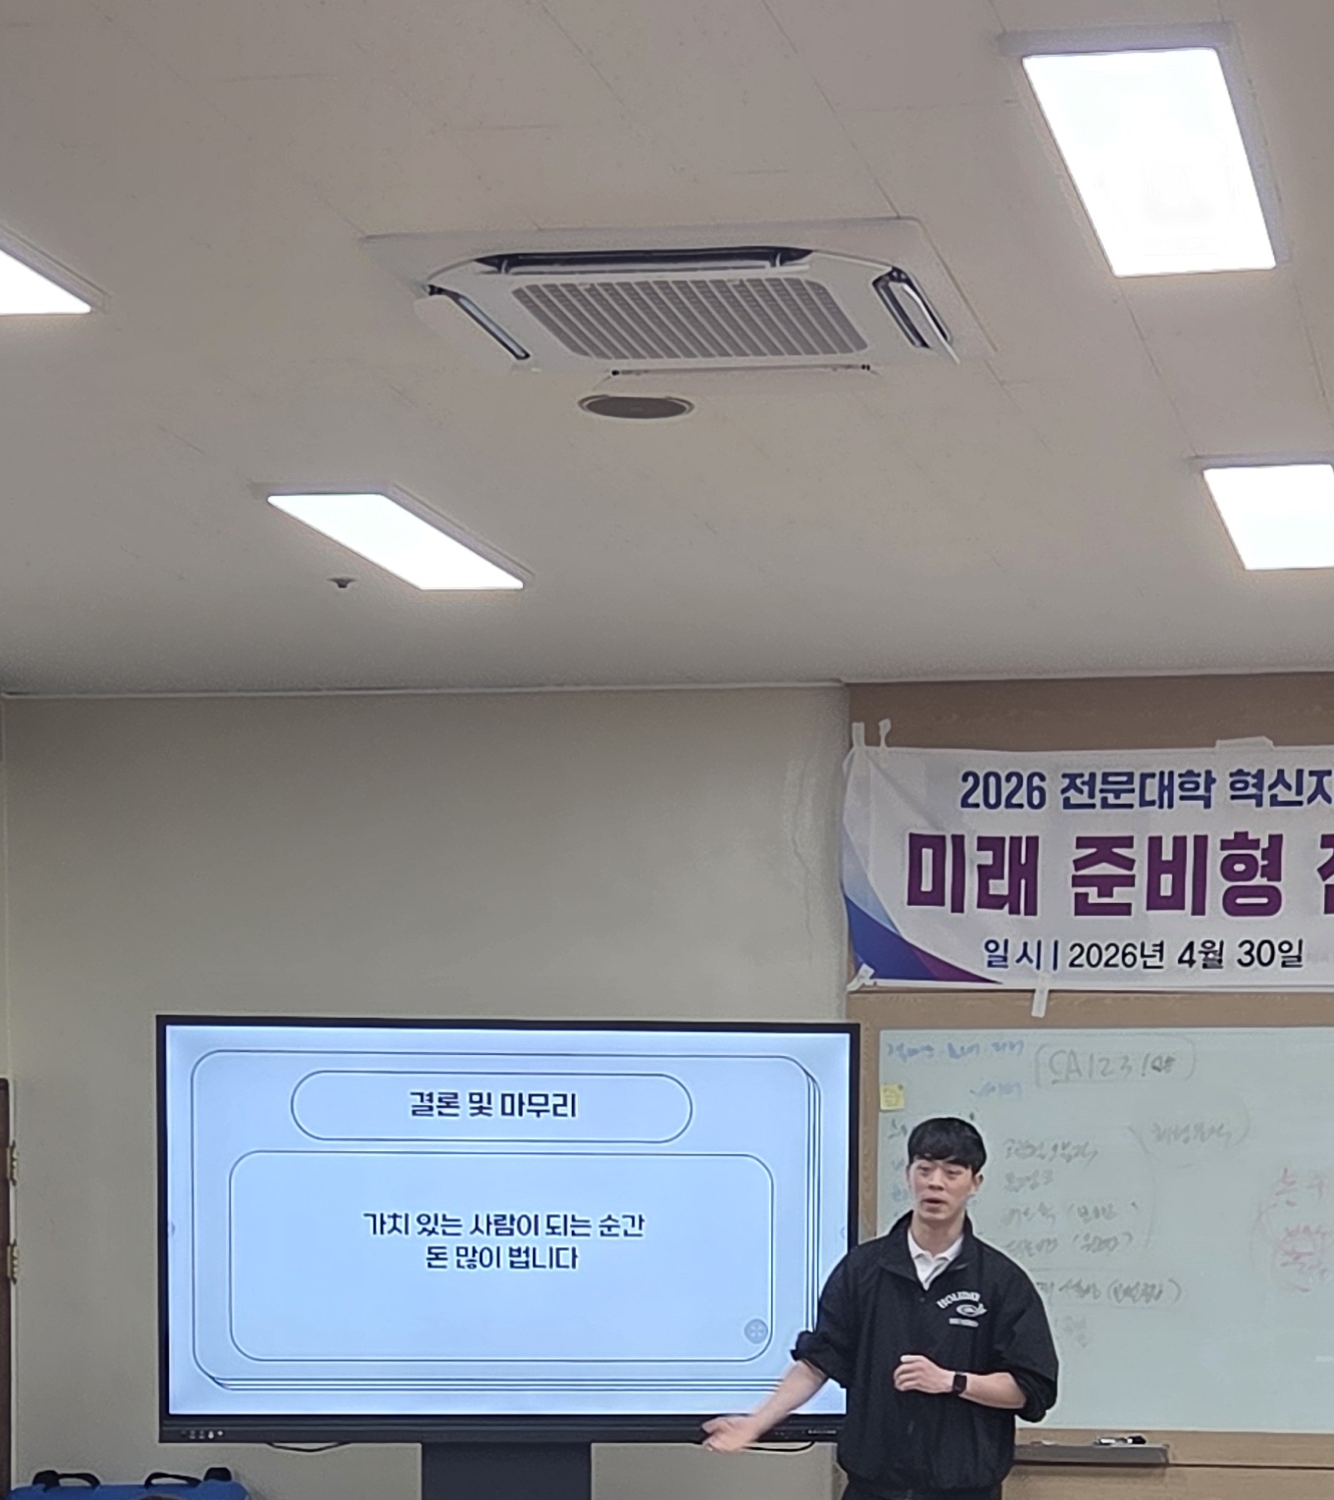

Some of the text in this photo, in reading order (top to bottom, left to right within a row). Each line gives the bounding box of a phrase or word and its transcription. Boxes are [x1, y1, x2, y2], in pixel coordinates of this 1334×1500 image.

[960, 770, 1047, 810] 2026
[1060, 769, 1217, 810] 전문대학
[906, 832, 1040, 917] 미래
[1071, 830, 1284, 917] 준비형
[984, 938, 1042, 971] 일시
[1068, 940, 1165, 970] 2026년
[1177, 939, 1225, 970] 4월
[1236, 938, 1303, 968] 30일
[410, 1091, 576, 1119] 결론 및 마무리
[363, 1212, 645, 1238] 가치 있는 사람이 되는 순간
[426, 1245, 578, 1270] 돈 많이 법니다
